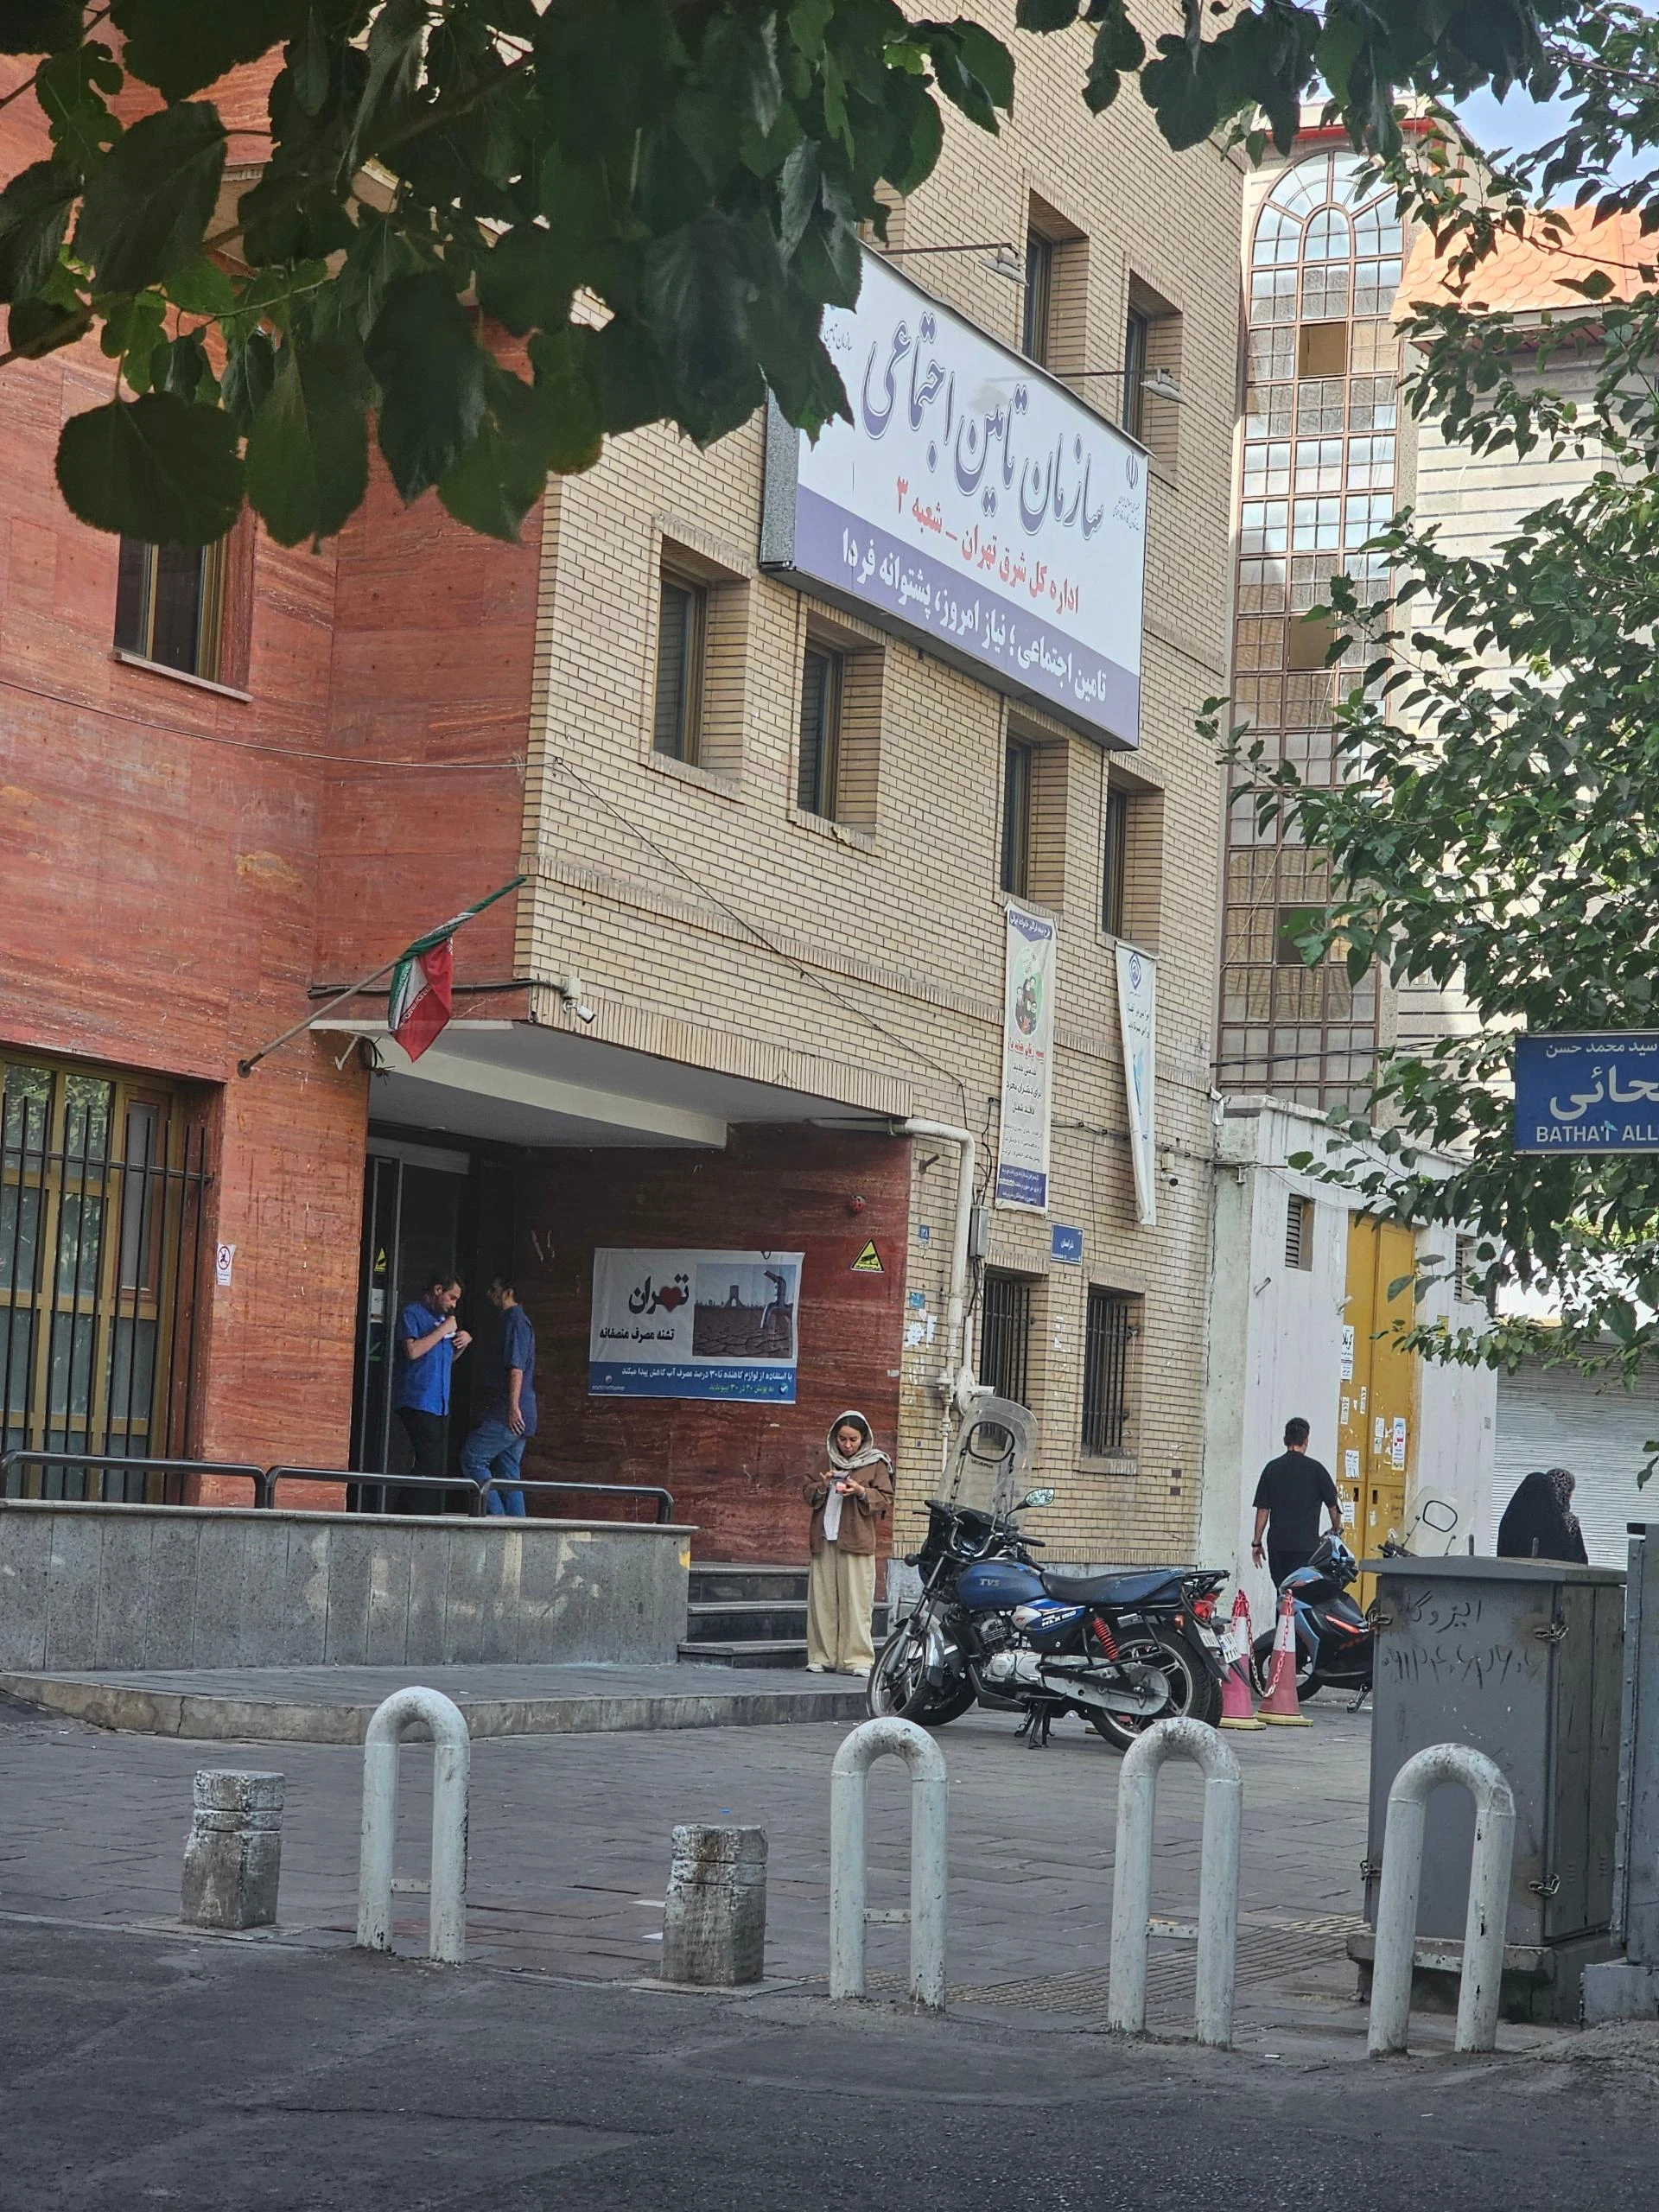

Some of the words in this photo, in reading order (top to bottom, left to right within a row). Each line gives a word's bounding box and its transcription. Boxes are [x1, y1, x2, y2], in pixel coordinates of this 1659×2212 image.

[861, 311, 956, 473] اجتماعی
[954, 383, 1029, 517] تامین
[1019, 433, 1104, 541] سازمان
[912, 497, 943, 534] شعبه
[842, 527, 876, 585] فردا
[962, 524, 997, 570] تهران
[880, 552, 931, 620] پشتوانه
[999, 547, 1027, 588] شرق
[1029, 561, 1047, 598] کل
[1050, 575, 1079, 614] اداره
[981, 608, 1007, 654] نیاز
[1074, 669, 1107, 702] تامین
[1545, 1044, 1582, 1058] حسن
[1585, 1042, 1625, 1053] محمد
[1628, 1042, 1658, 1057] سید
[1549, 1065, 1659, 1122] حائی
[1621, 1124, 1659, 1141] ALL
[628, 1273, 690, 1314] تران
[600, 1327, 629, 1340] منصفانه
[631, 1328, 655, 1344] مصرف
[657, 1328, 675, 1340] تشنه
[677, 1369, 693, 1379] مصرف
[766, 1371, 786, 1381] استفاده
[979, 1578, 1001, 1587] TVS
